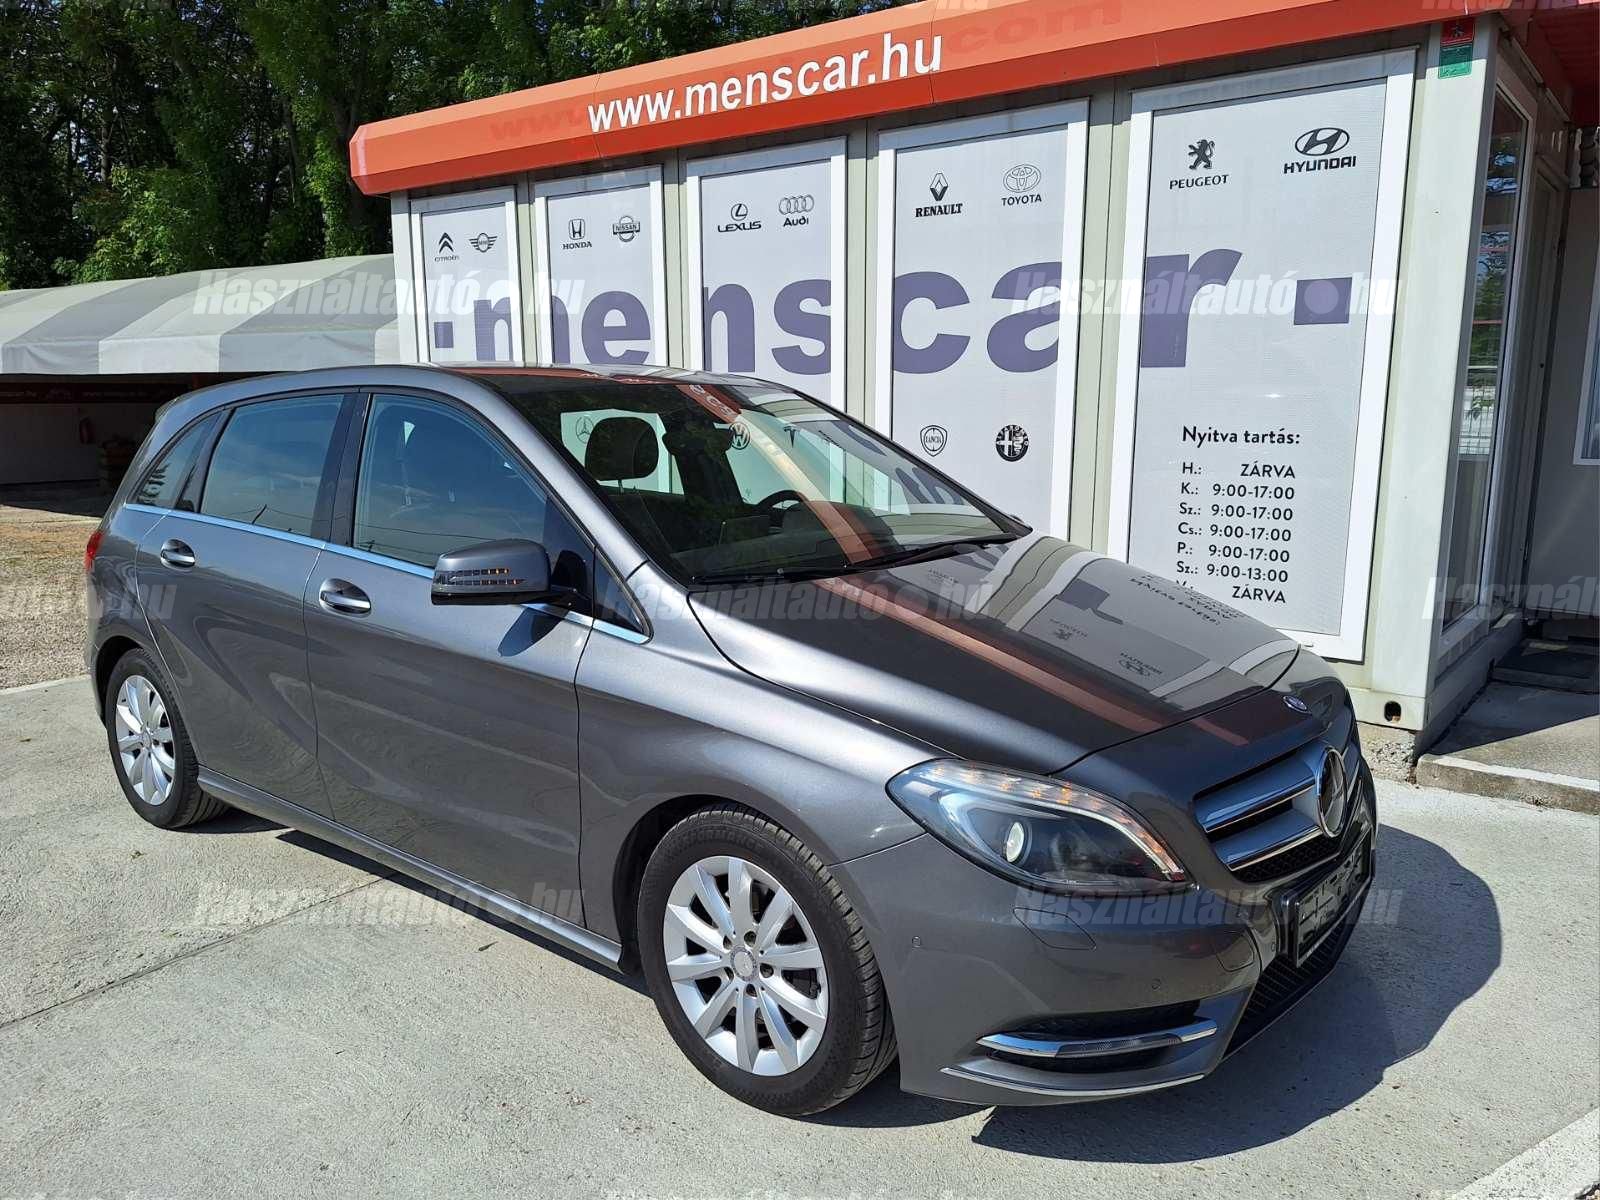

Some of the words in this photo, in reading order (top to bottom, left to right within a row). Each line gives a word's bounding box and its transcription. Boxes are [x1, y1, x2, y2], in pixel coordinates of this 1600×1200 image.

[588, 32, 943, 133] www.menscar.hu
[1283, 155, 1357, 174] HYUNDAI
[1169, 174, 1229, 189] PEUGEOT
[1001, 193, 1042, 206] TOYOTA
[915, 203, 963, 218] RENAULT
[717, 220, 762, 233] LEXUS
[783, 216, 809, 227] Audi
[562, 240, 592, 250] HONDA
[1182, 425, 1238, 448] Nyitva
[1243, 428, 1300, 445] tartás:
[1182, 461, 1202, 475] H.:
[1240, 460, 1296, 479] ZÁRVA
[1181, 482, 1199, 495] K.:
[1212, 483, 1295, 500] 9:00-17:00
[1179, 502, 1201, 516] Sz.:
[1211, 503, 1294, 521] 9:00-17:00
[1178, 522, 1202, 536] Cs.:
[1209, 524, 1292, 542] 9:00-17:00
[1177, 541, 1193, 555] P.:
[1208, 544, 1290, 563] 9:00-17:00
[1176, 560, 1199, 575] Sz.:
[1206, 563, 1288, 583] 9:00-13:00
[1231, 584, 1286, 604] ZÁRVA
